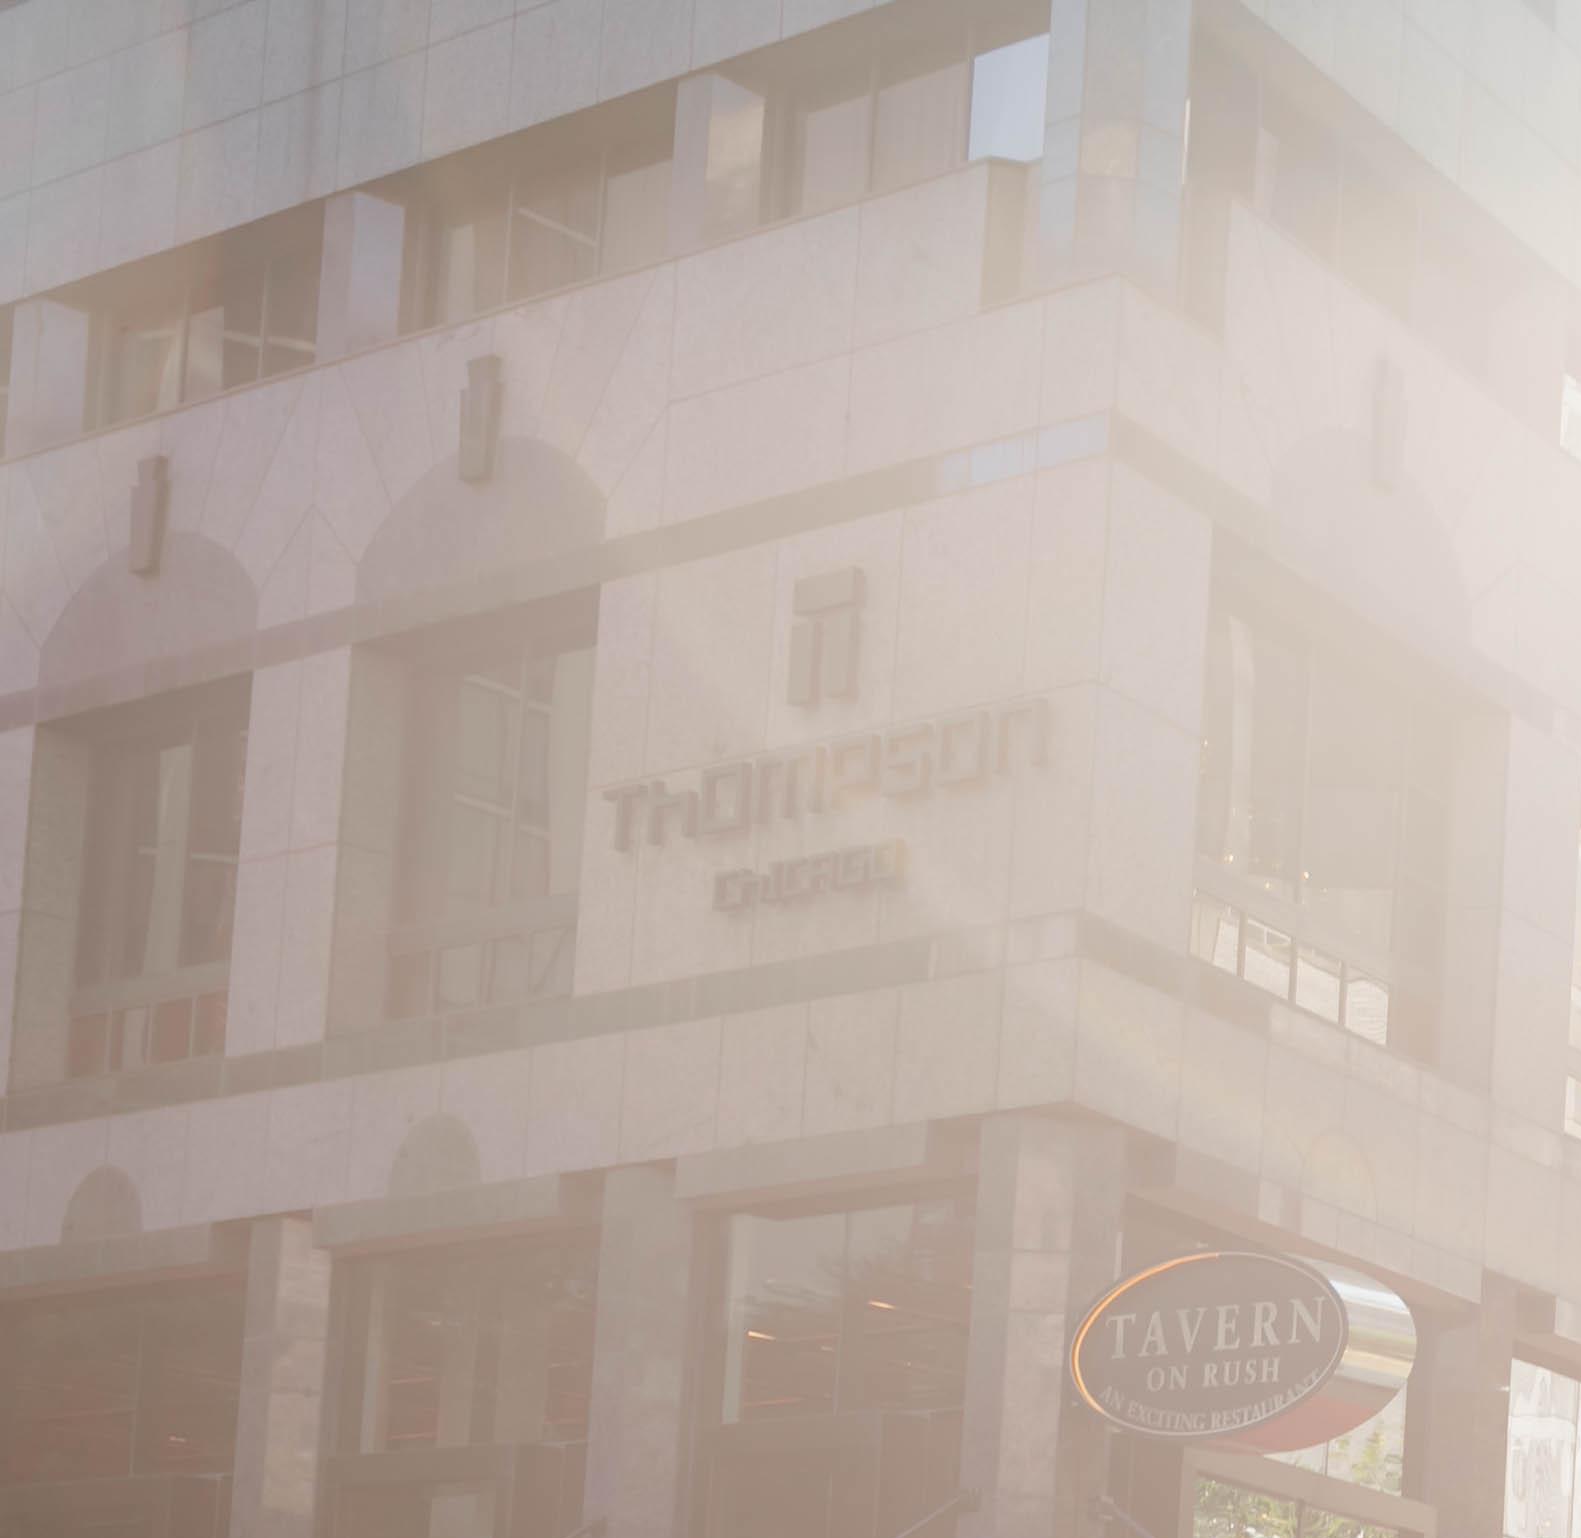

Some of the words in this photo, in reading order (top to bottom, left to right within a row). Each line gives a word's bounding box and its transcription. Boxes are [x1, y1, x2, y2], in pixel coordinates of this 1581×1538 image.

[1105, 1296, 1326, 1360] TAVERN
[1147, 1365, 1189, 1392] ON
[1202, 1354, 1281, 1389] RUSH
[1099, 1385, 1126, 1412] AN
[1127, 1400, 1207, 1431] EXCITING
